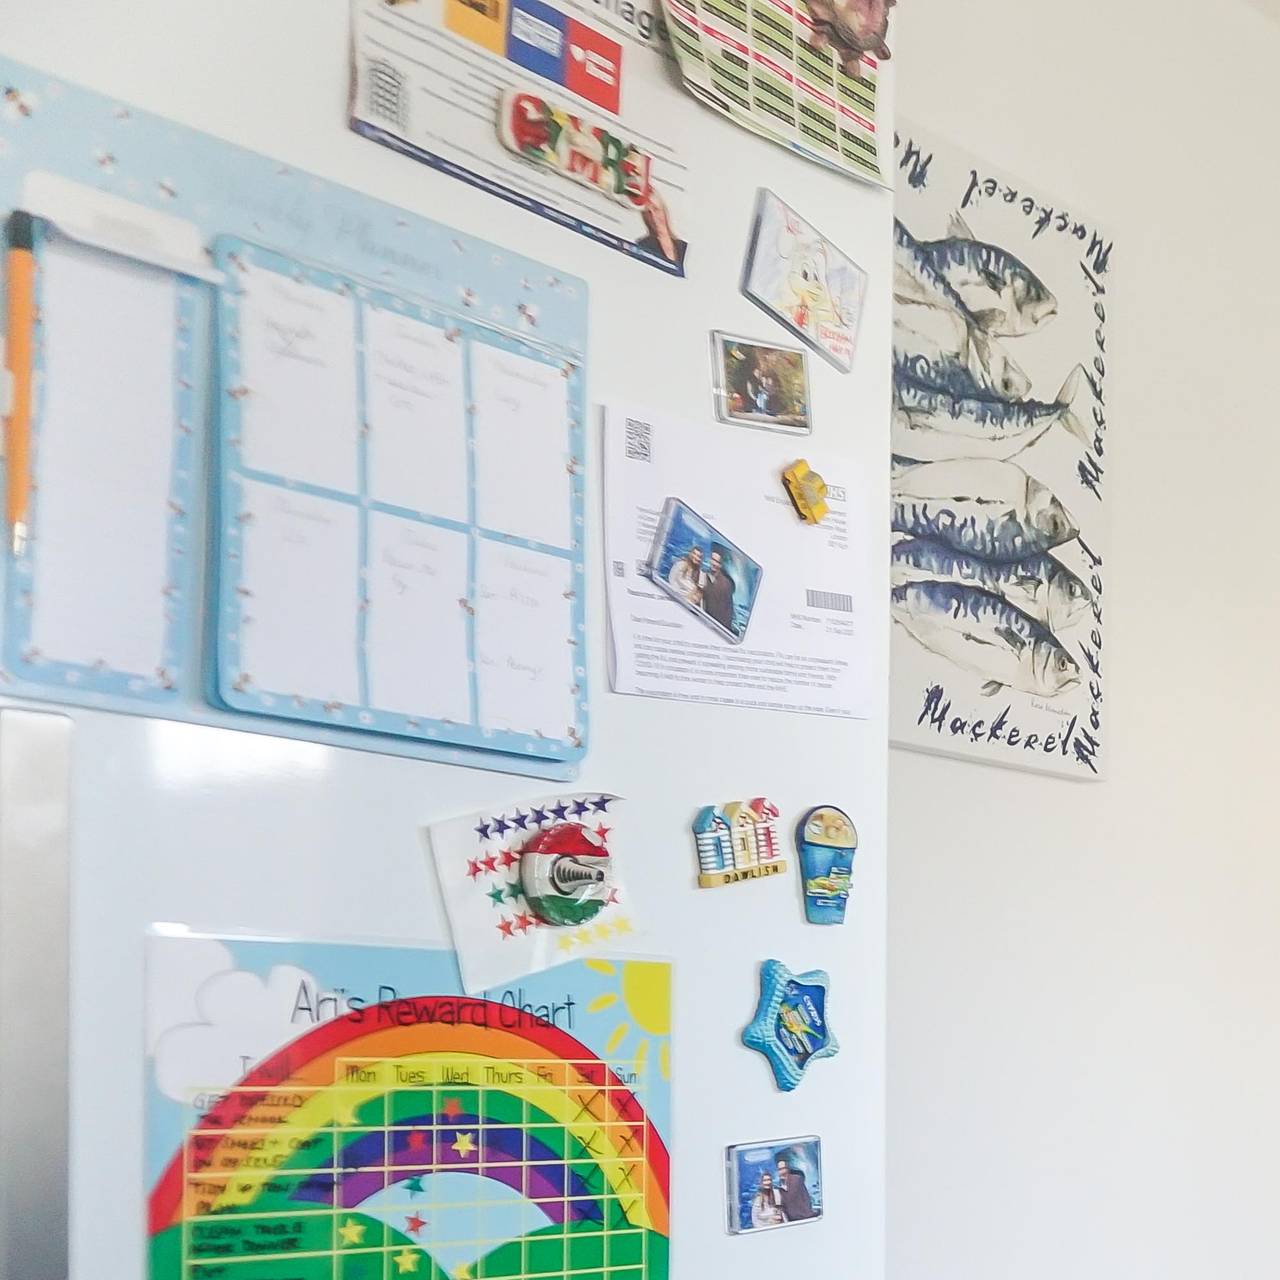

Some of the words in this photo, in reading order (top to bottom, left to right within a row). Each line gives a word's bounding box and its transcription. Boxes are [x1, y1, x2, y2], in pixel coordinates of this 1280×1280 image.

[917, 683, 1078, 756] Mackerel
[377, 985, 489, 1031] Reward
[501, 988, 577, 1029] Chart
[346, 1065, 377, 1083] Mon
[393, 1065, 425, 1083] Tues
[441, 1065, 471, 1084] Wed
[484, 1066, 524, 1085] Thurs
[615, 1067, 638, 1084] Sun
